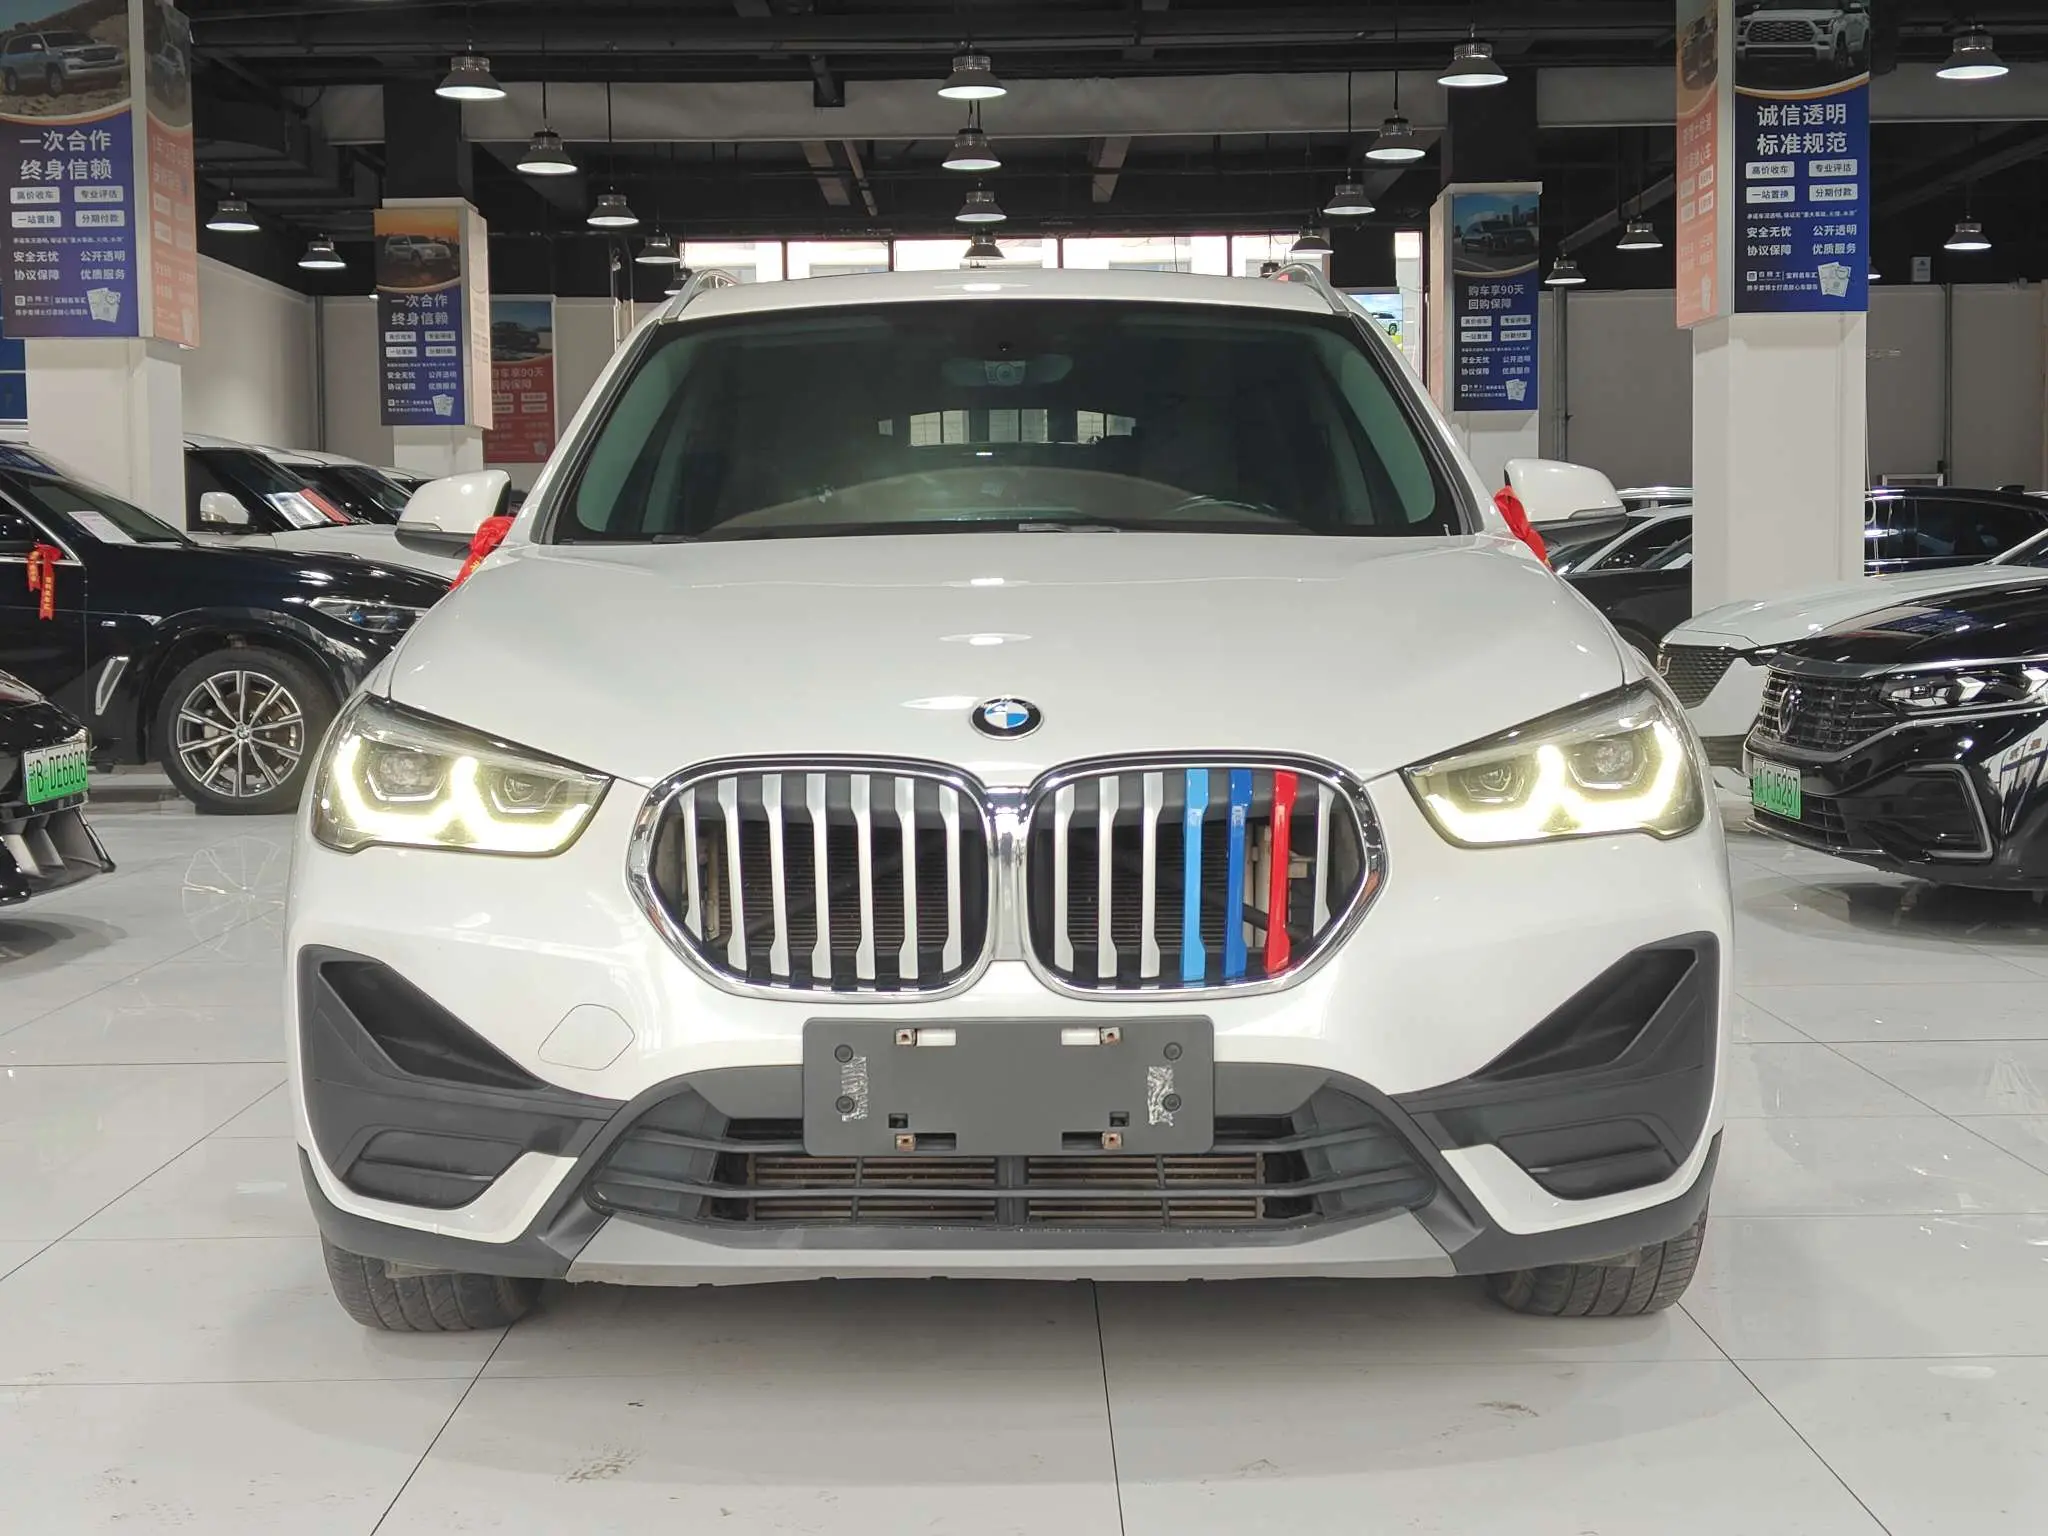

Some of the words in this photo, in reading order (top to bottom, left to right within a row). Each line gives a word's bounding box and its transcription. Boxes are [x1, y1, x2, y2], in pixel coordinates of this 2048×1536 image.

[1757, 103, 1847, 127] 诚信透明
[19, 129, 112, 152] 一次合作
[1757, 132, 1848, 156] 标准规范
[20, 159, 112, 181] 终身信赖
[1747, 226, 1792, 238] 安全无忧
[1812, 224, 1857, 236] 公开透明
[1747, 244, 1792, 256] 协议保障
[1812, 243, 1856, 255] 优质服务
[13, 251, 59, 262] 安全无忧
[80, 250, 126, 262] 公开透明
[14, 269, 60, 281] 协议保障
[80, 269, 125, 280] 优质服务
[1468, 284, 1524, 296] 购车享90天
[391, 294, 448, 308] 一次合作
[1468, 298, 1512, 310] 回购保障
[391, 312, 448, 326] 终身信赖
